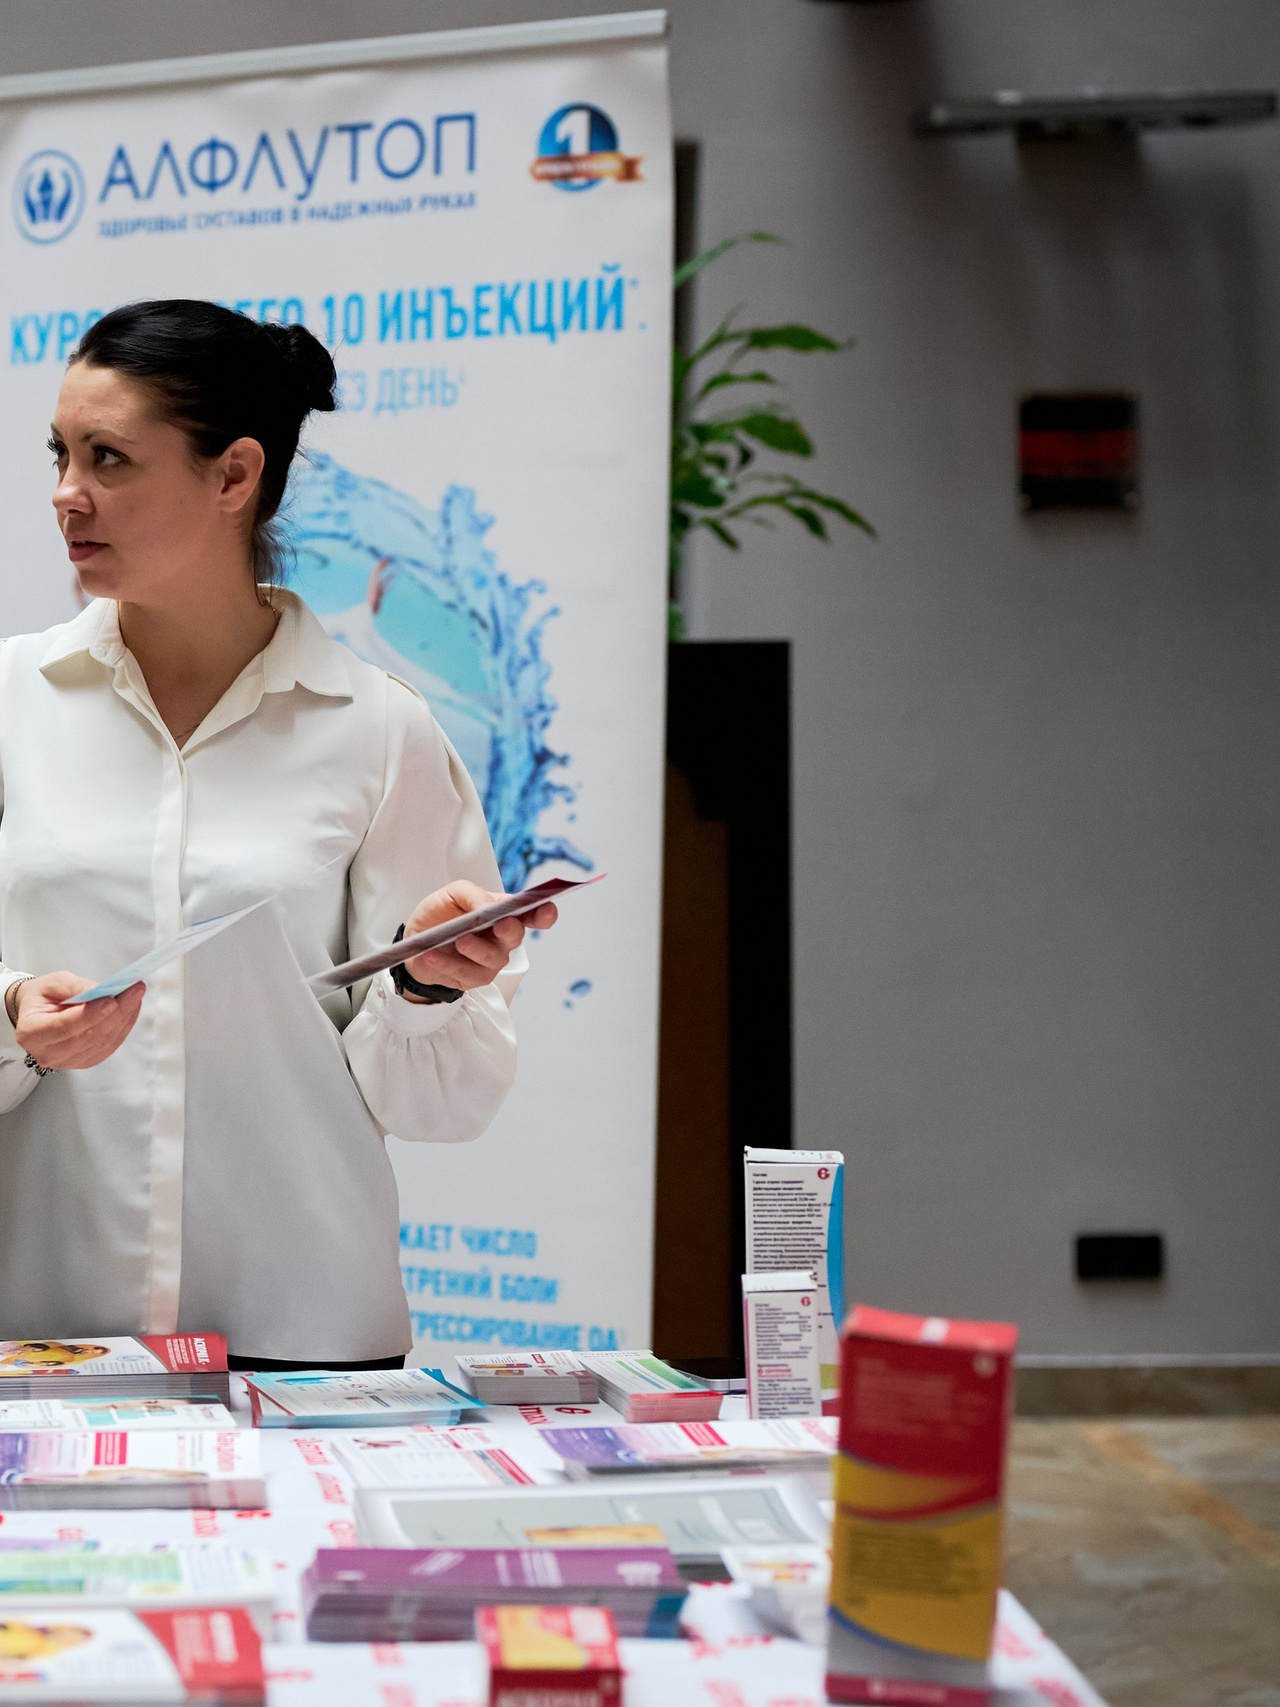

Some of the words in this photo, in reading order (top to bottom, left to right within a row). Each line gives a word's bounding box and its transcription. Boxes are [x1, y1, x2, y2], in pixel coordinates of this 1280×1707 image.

[98, 113, 477, 201] АЛФЛУТОП
[323, 291, 365, 347] 10
[499, 1273, 558, 1304] БОЛИ
